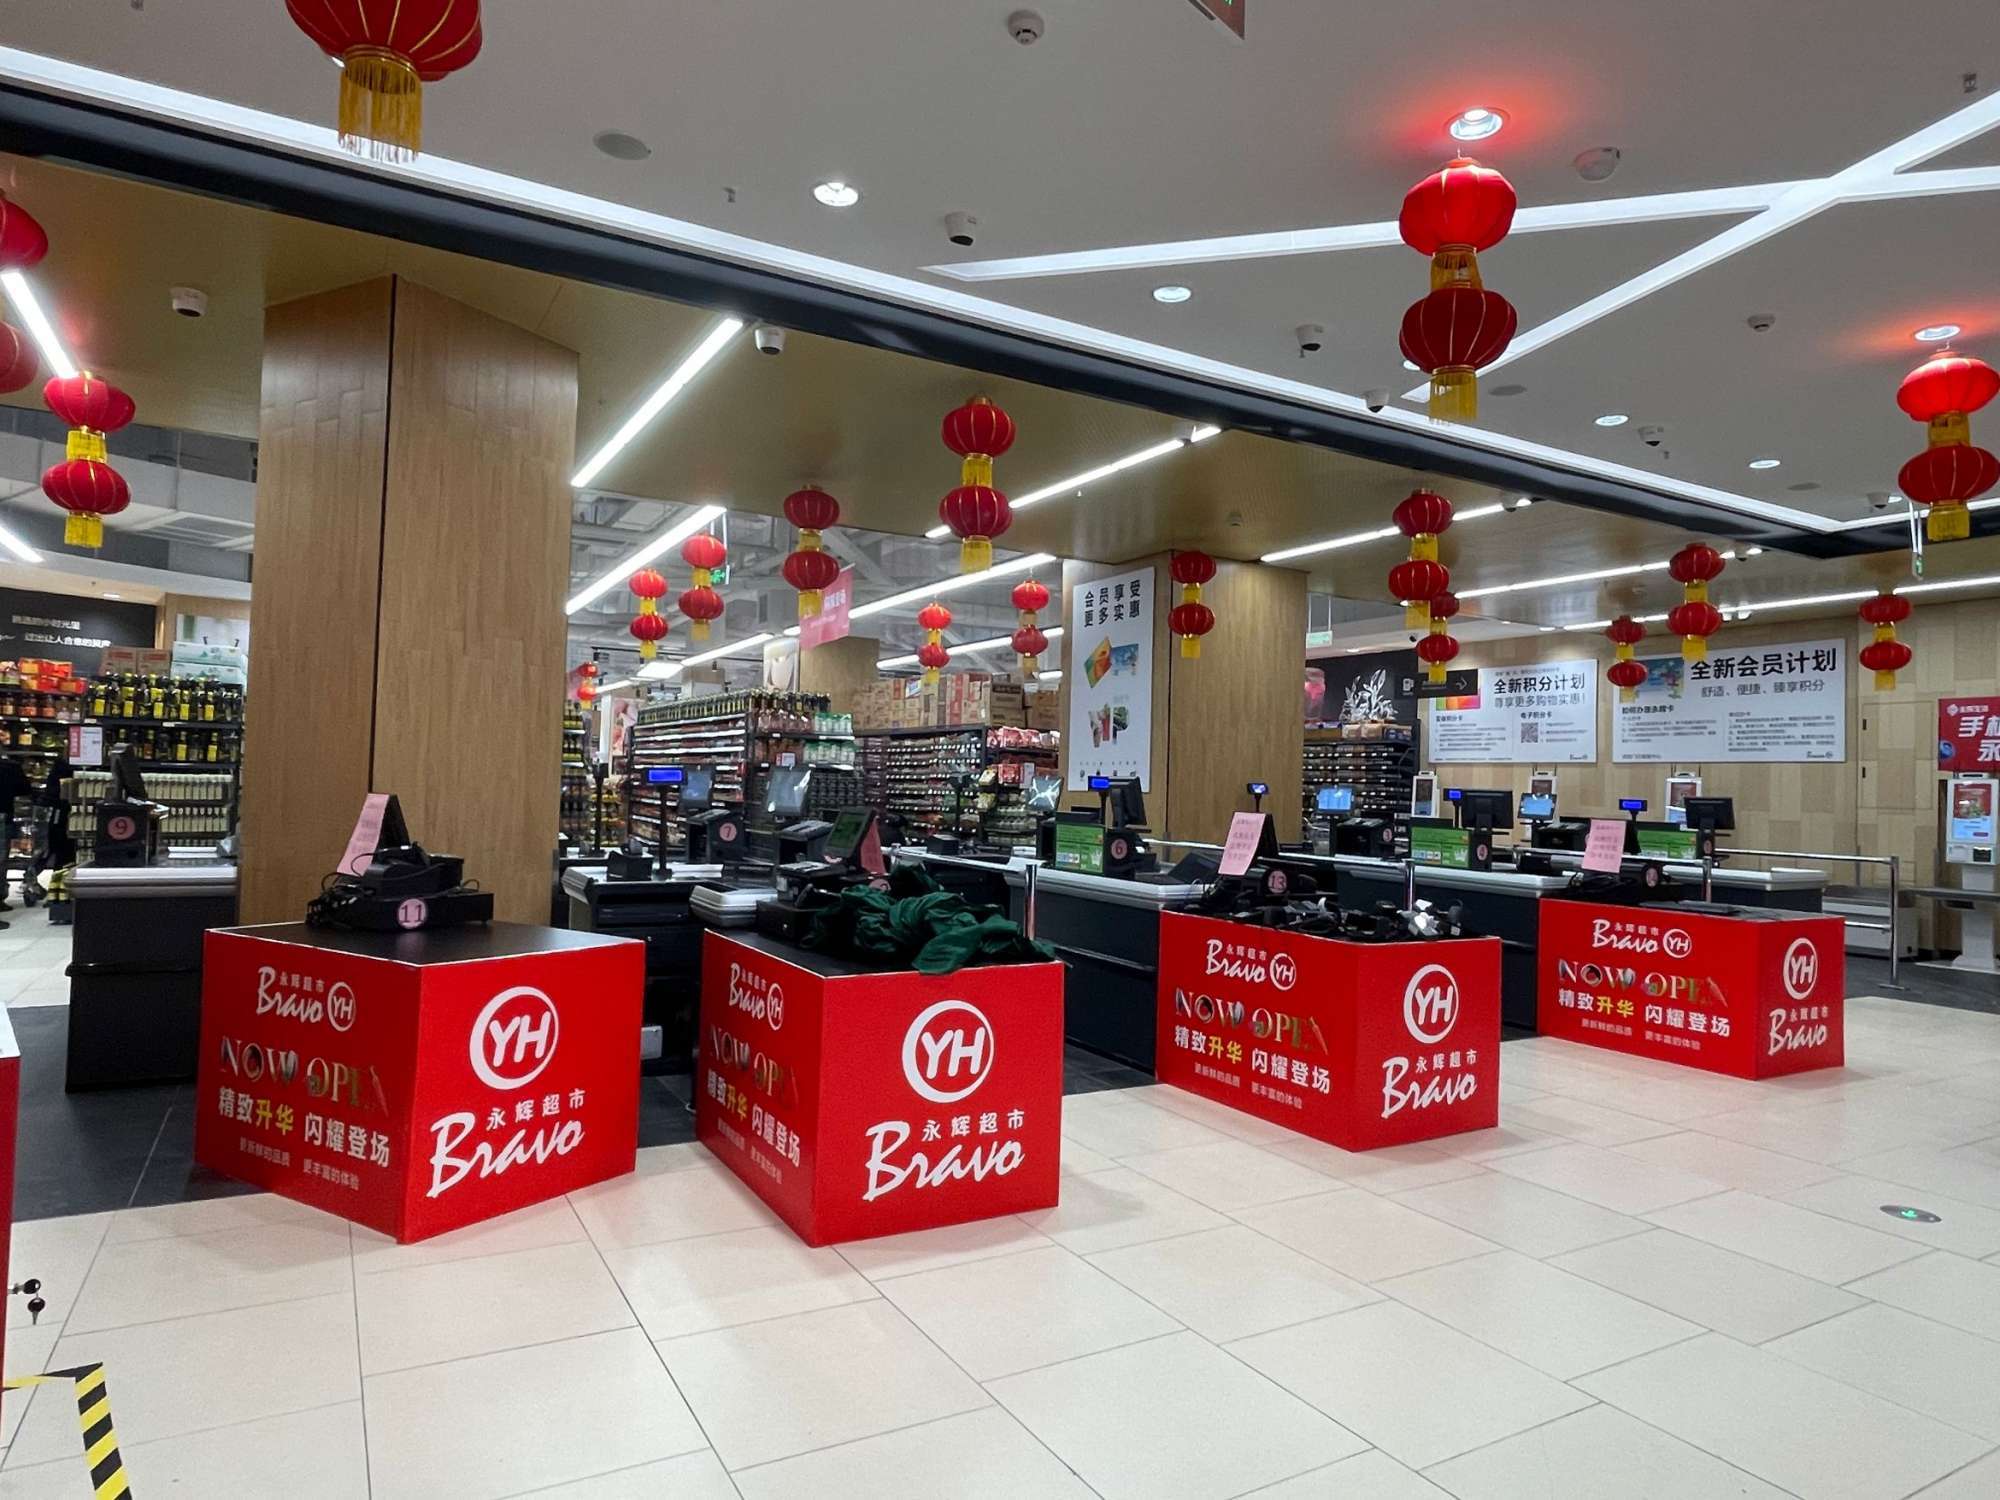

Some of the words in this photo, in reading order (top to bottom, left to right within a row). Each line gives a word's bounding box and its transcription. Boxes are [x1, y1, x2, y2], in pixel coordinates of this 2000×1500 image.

[1084, 600, 1140, 628] 更多实惠
[1085, 579, 1141, 608] 会员享受
[1494, 672, 1585, 694] 全新积分计划
[1690, 648, 1837, 681] 全新会员计划
[115, 819, 128, 835] 9
[401, 904, 425, 923] 11
[1592, 919, 1659, 953] Bravo
[1206, 939, 1267, 983] Bravo
[1559, 959, 1636, 990] NOW
[256, 966, 324, 1023] Bravo
[729, 963, 766, 1020] Bravo
[1176, 987, 1245, 1029] NOW
[1559, 988, 1634, 1018] 精致升华
[1645, 1004, 1730, 1038] 闪耀登场
[1768, 1008, 1827, 1056] Bravo
[219, 1036, 299, 1084] NOW
[1174, 1025, 1243, 1064] 精致升华
[1252, 1048, 1330, 1094] 闪耀登场
[486, 1088, 586, 1130] 永辉超市
[1381, 1056, 1477, 1119] Bravo
[218, 1086, 294, 1136] 精致升华
[305, 1112, 390, 1168] 闪耀登场
[752, 1103, 800, 1167] 闪耀登场
[922, 1108, 1024, 1141] 永辉超市
[427, 1112, 585, 1198] Bravo
[862, 1120, 1025, 1201] Bravo
